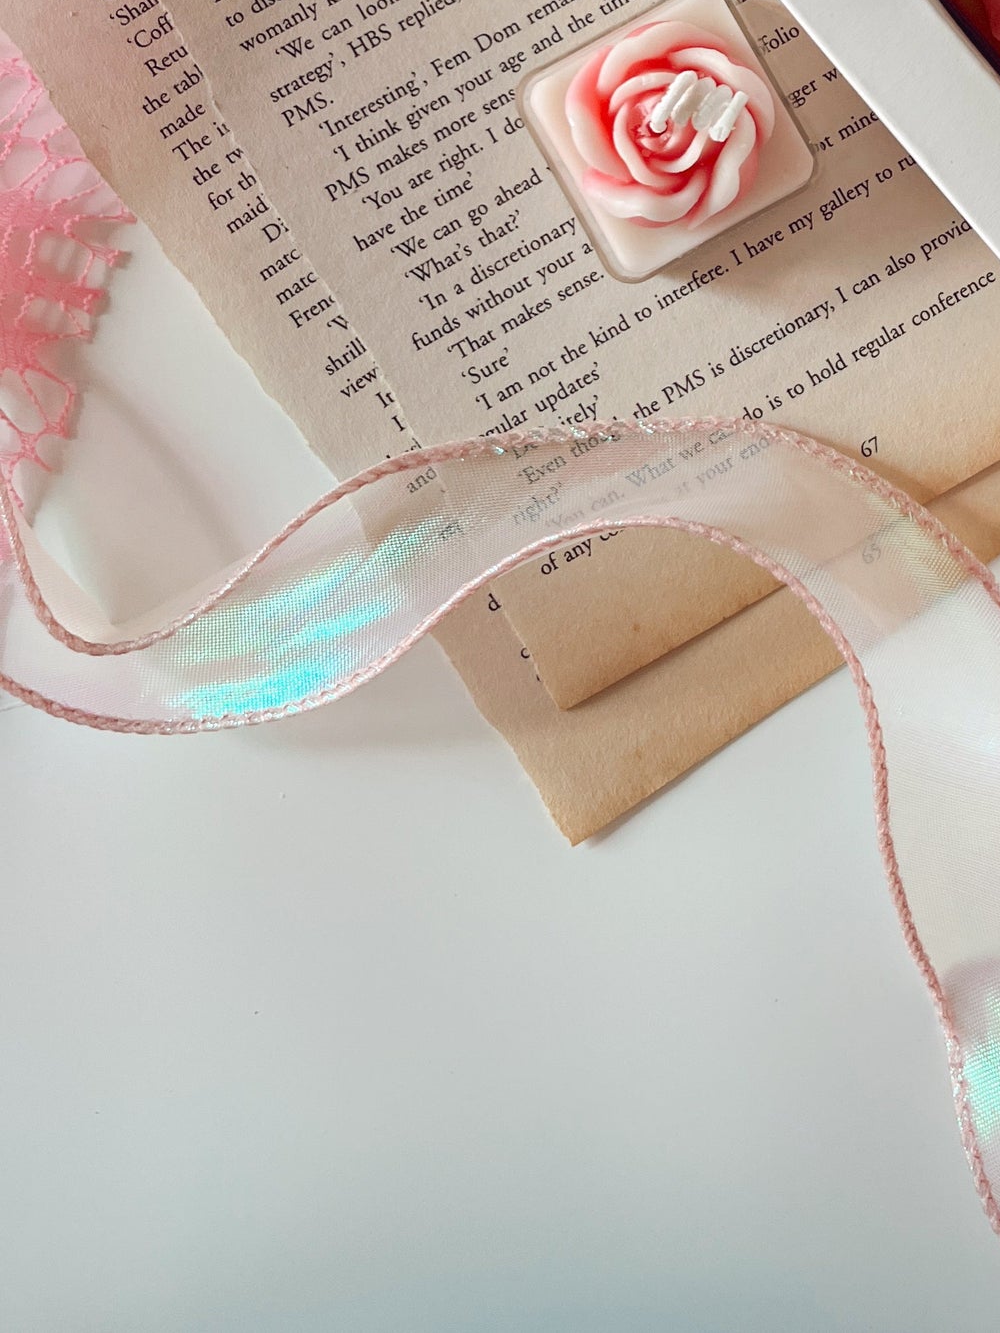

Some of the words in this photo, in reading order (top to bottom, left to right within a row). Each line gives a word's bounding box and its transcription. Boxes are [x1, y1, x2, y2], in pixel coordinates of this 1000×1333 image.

[237, 1, 317, 52] womanly
[345, 22, 392, 58] HBS
[471, 21, 522, 53] Dom
[158, 102, 206, 140] made
[279, 90, 334, 128] PMS.
[353, 117, 403, 153] think
[404, 93, 452, 130] given
[452, 67, 494, 103] your
[170, 134, 212, 162] The
[323, 165, 370, 203] PMS
[375, 137, 429, 175] makes
[432, 110, 478, 143] more
[437, 141, 484, 173] right.
[493, 166, 543, 207] ahead
[351, 222, 396, 252] have
[469, 216, 576, 285] discretionary
[587, 312, 632, 348] kind
[653, 263, 730, 310] interfere.
[741, 229, 785, 259] have
[818, 177, 870, 222] gallery
[410, 314, 461, 352] funds
[463, 275, 533, 320] without
[534, 249, 576, 286] your
[499, 297, 553, 334] makes
[556, 270, 605, 302] sense.
[660, 367, 706, 405] PMS
[728, 299, 836, 367] discretionary,
[883, 251, 916, 277] also
[804, 351, 849, 387] hold
[850, 321, 907, 362] regular
[910, 270, 997, 327] conference
[859, 434, 878, 458] 67
